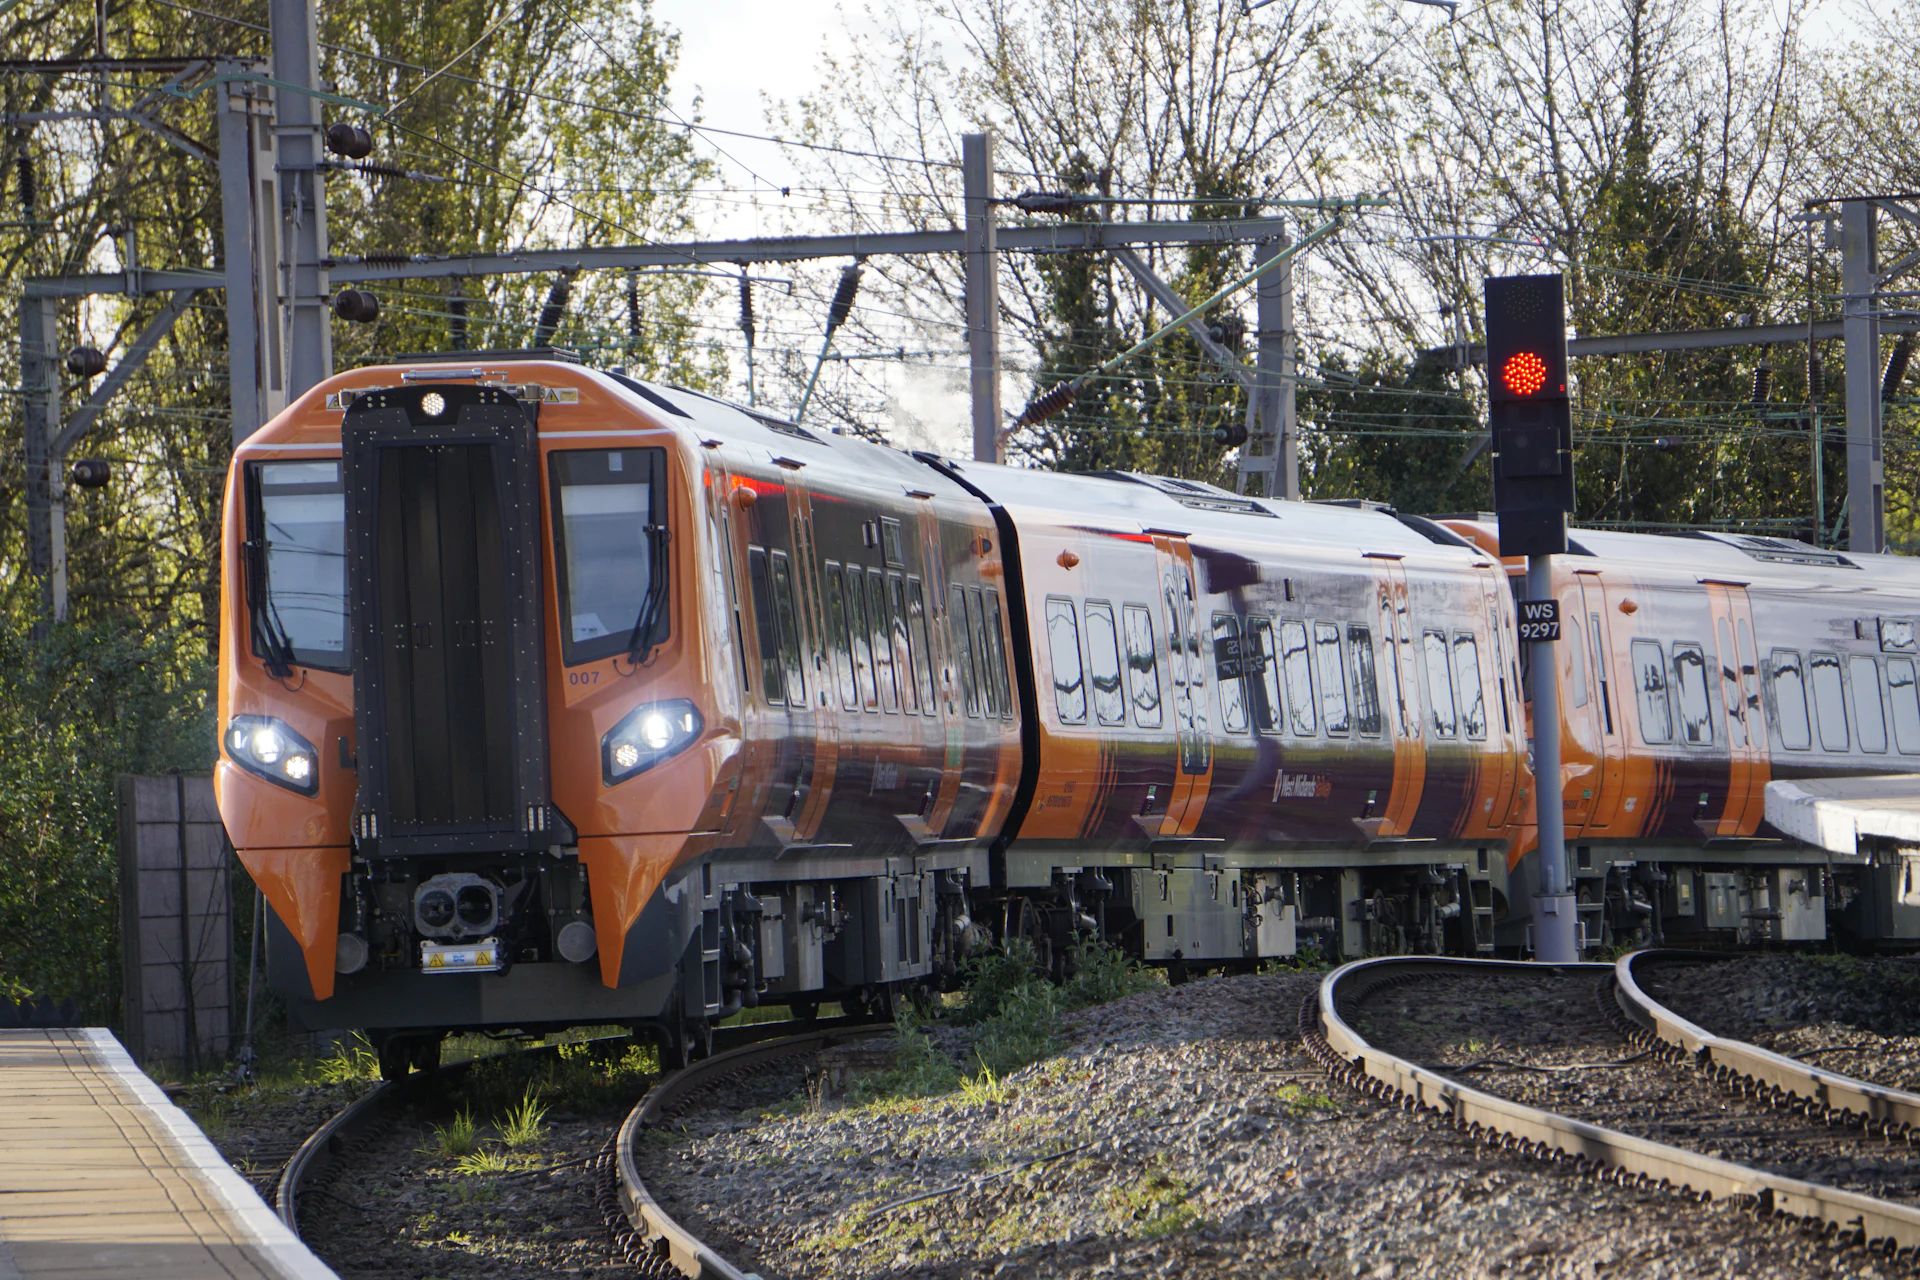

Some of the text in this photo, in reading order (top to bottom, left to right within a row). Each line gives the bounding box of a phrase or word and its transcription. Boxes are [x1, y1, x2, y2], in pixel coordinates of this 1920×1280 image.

[1525, 603, 1554, 619] WS
[1520, 622, 1559, 638] 9297
[569, 671, 600, 686] 007
